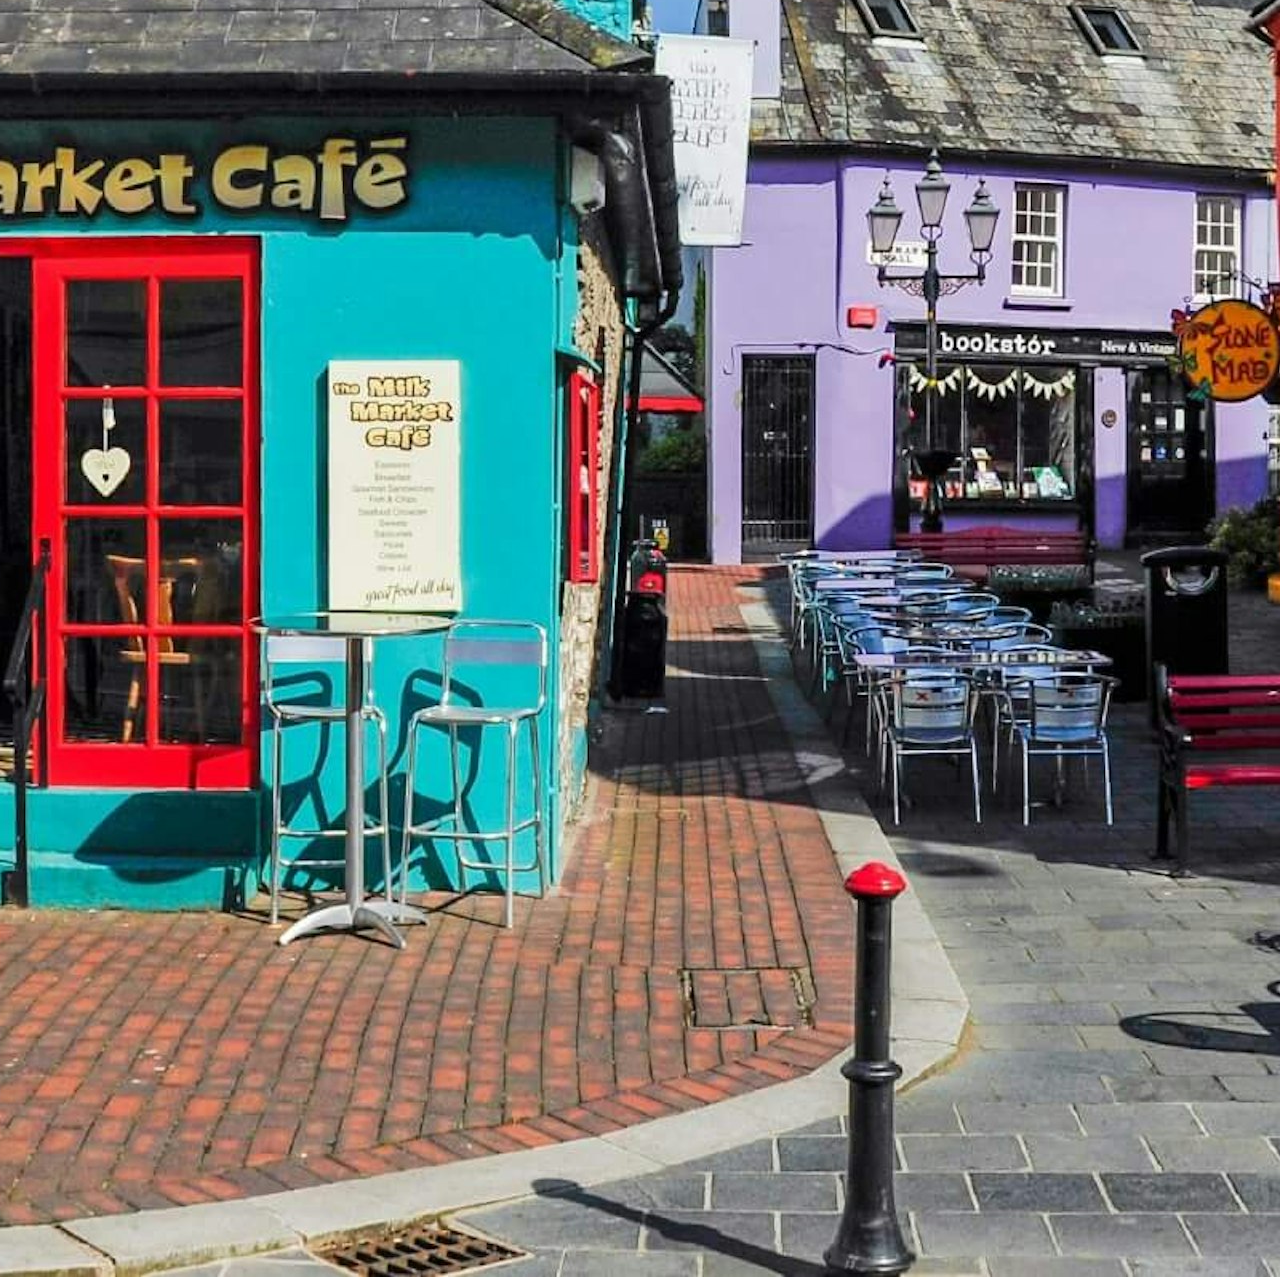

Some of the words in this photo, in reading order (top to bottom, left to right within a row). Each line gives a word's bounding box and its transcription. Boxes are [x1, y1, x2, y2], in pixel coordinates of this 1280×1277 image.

[940, 331, 1056, 356] bookstór
[1101, 339, 1127, 354] New
[1207, 322, 1271, 352] STONE
[1211, 358, 1270, 384] MAD
[333, 382, 360, 395] the
[367, 375, 431, 398] Milk
[350, 400, 454, 422] Market
